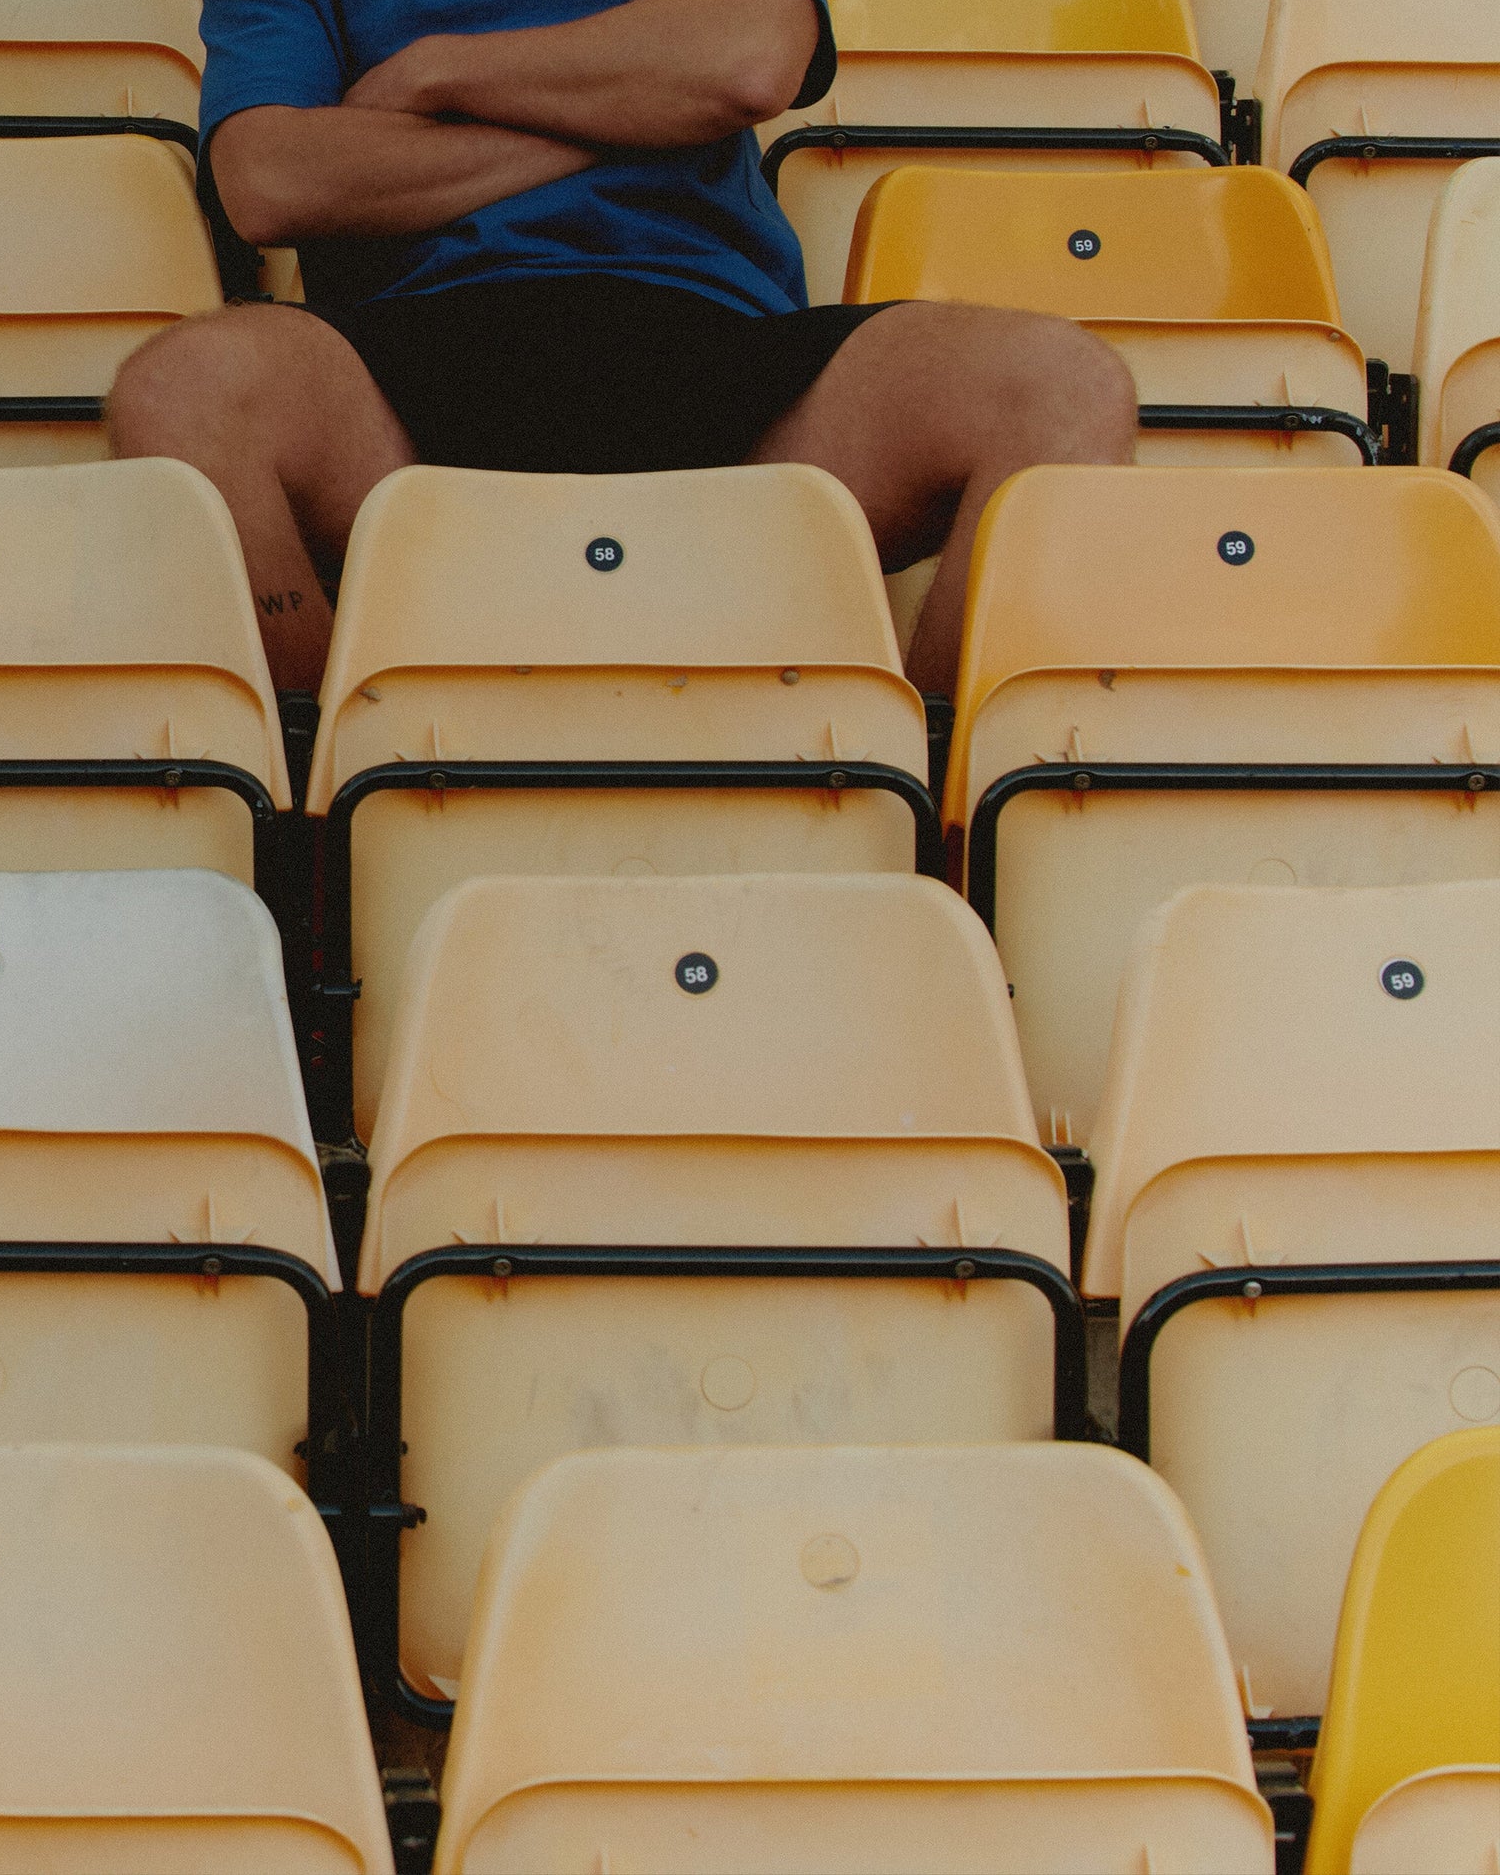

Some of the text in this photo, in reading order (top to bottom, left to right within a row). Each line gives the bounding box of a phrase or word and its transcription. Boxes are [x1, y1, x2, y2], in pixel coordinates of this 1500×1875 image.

[1076, 240, 1093, 252] 59
[595, 548, 615, 561] 58
[1226, 541, 1246, 555] 59
[685, 966, 708, 983] 58
[1391, 973, 1414, 990] 59
